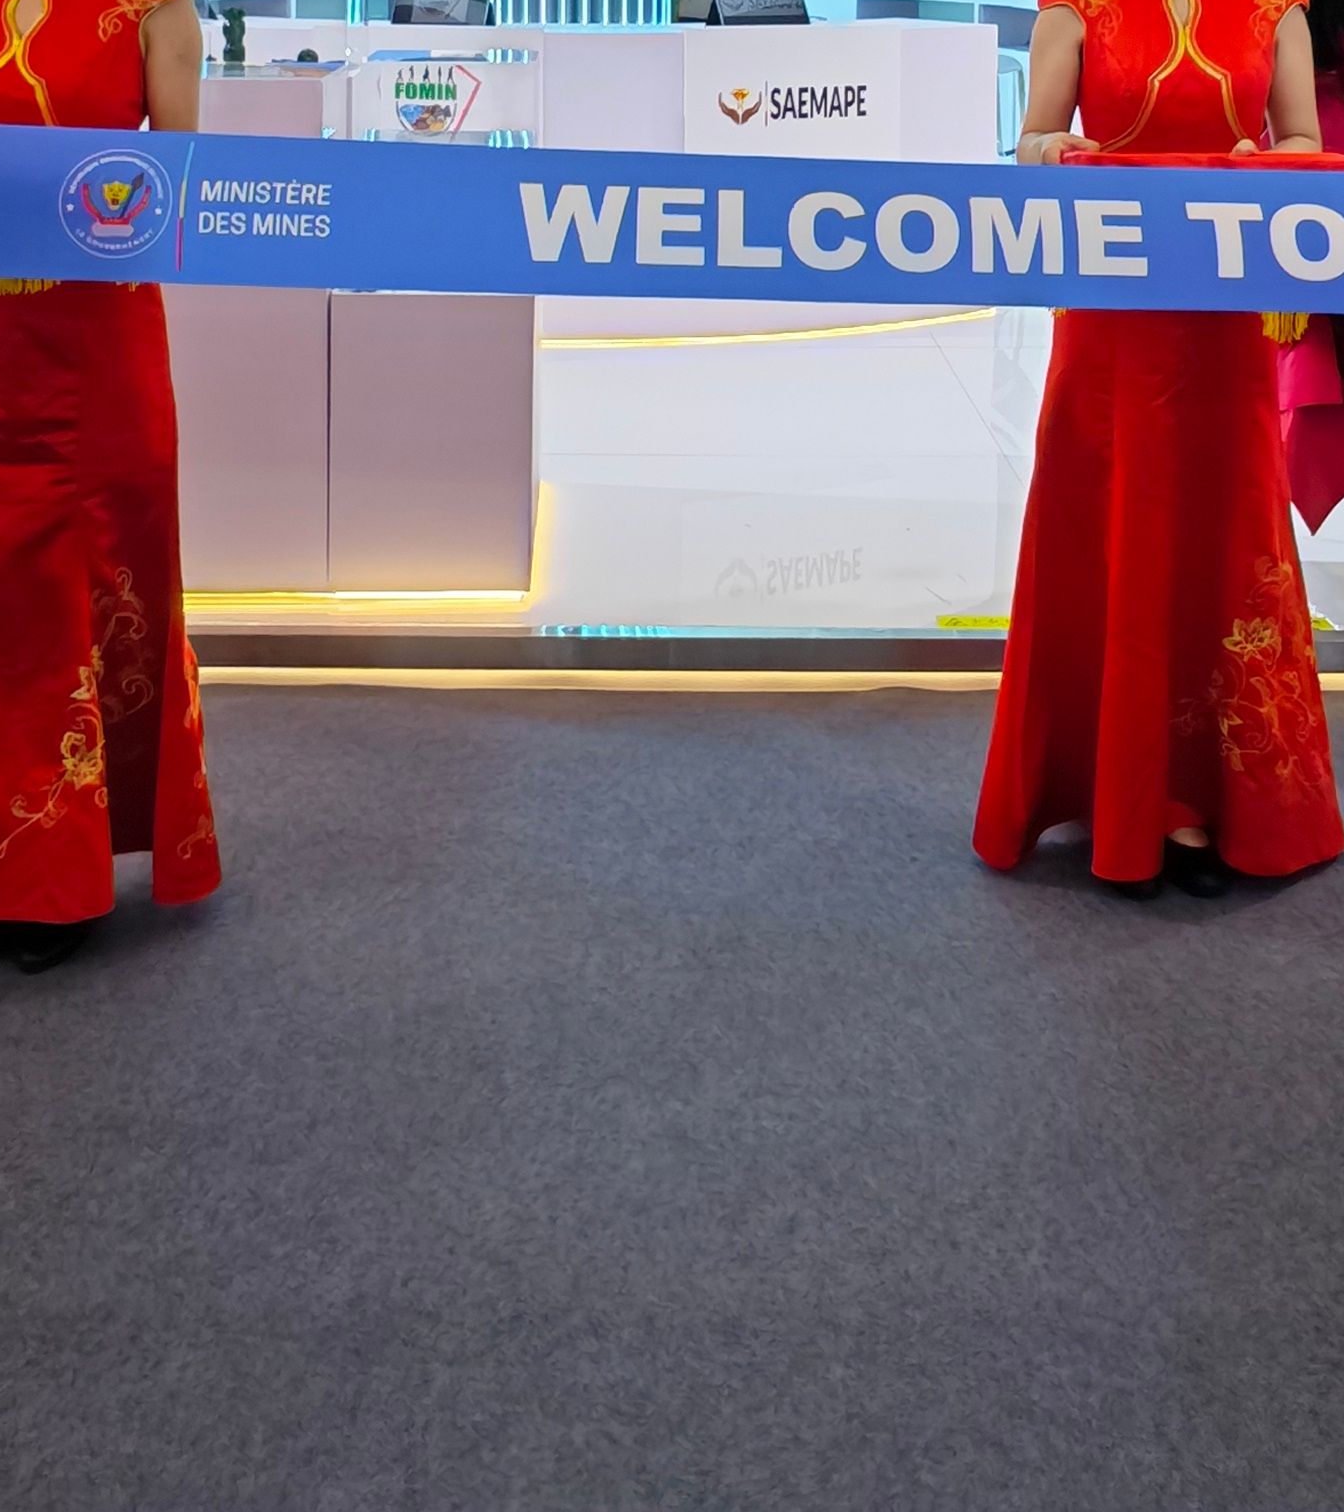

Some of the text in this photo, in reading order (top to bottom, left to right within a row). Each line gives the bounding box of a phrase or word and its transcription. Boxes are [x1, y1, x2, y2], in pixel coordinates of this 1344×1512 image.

[394, 82, 457, 101] FOMIN
[770, 85, 867, 120] SAEMAPE
[200, 179, 333, 206] MINISTÈRE
[198, 211, 331, 238] DES MINES
[519, 182, 1148, 276] WELCOME
